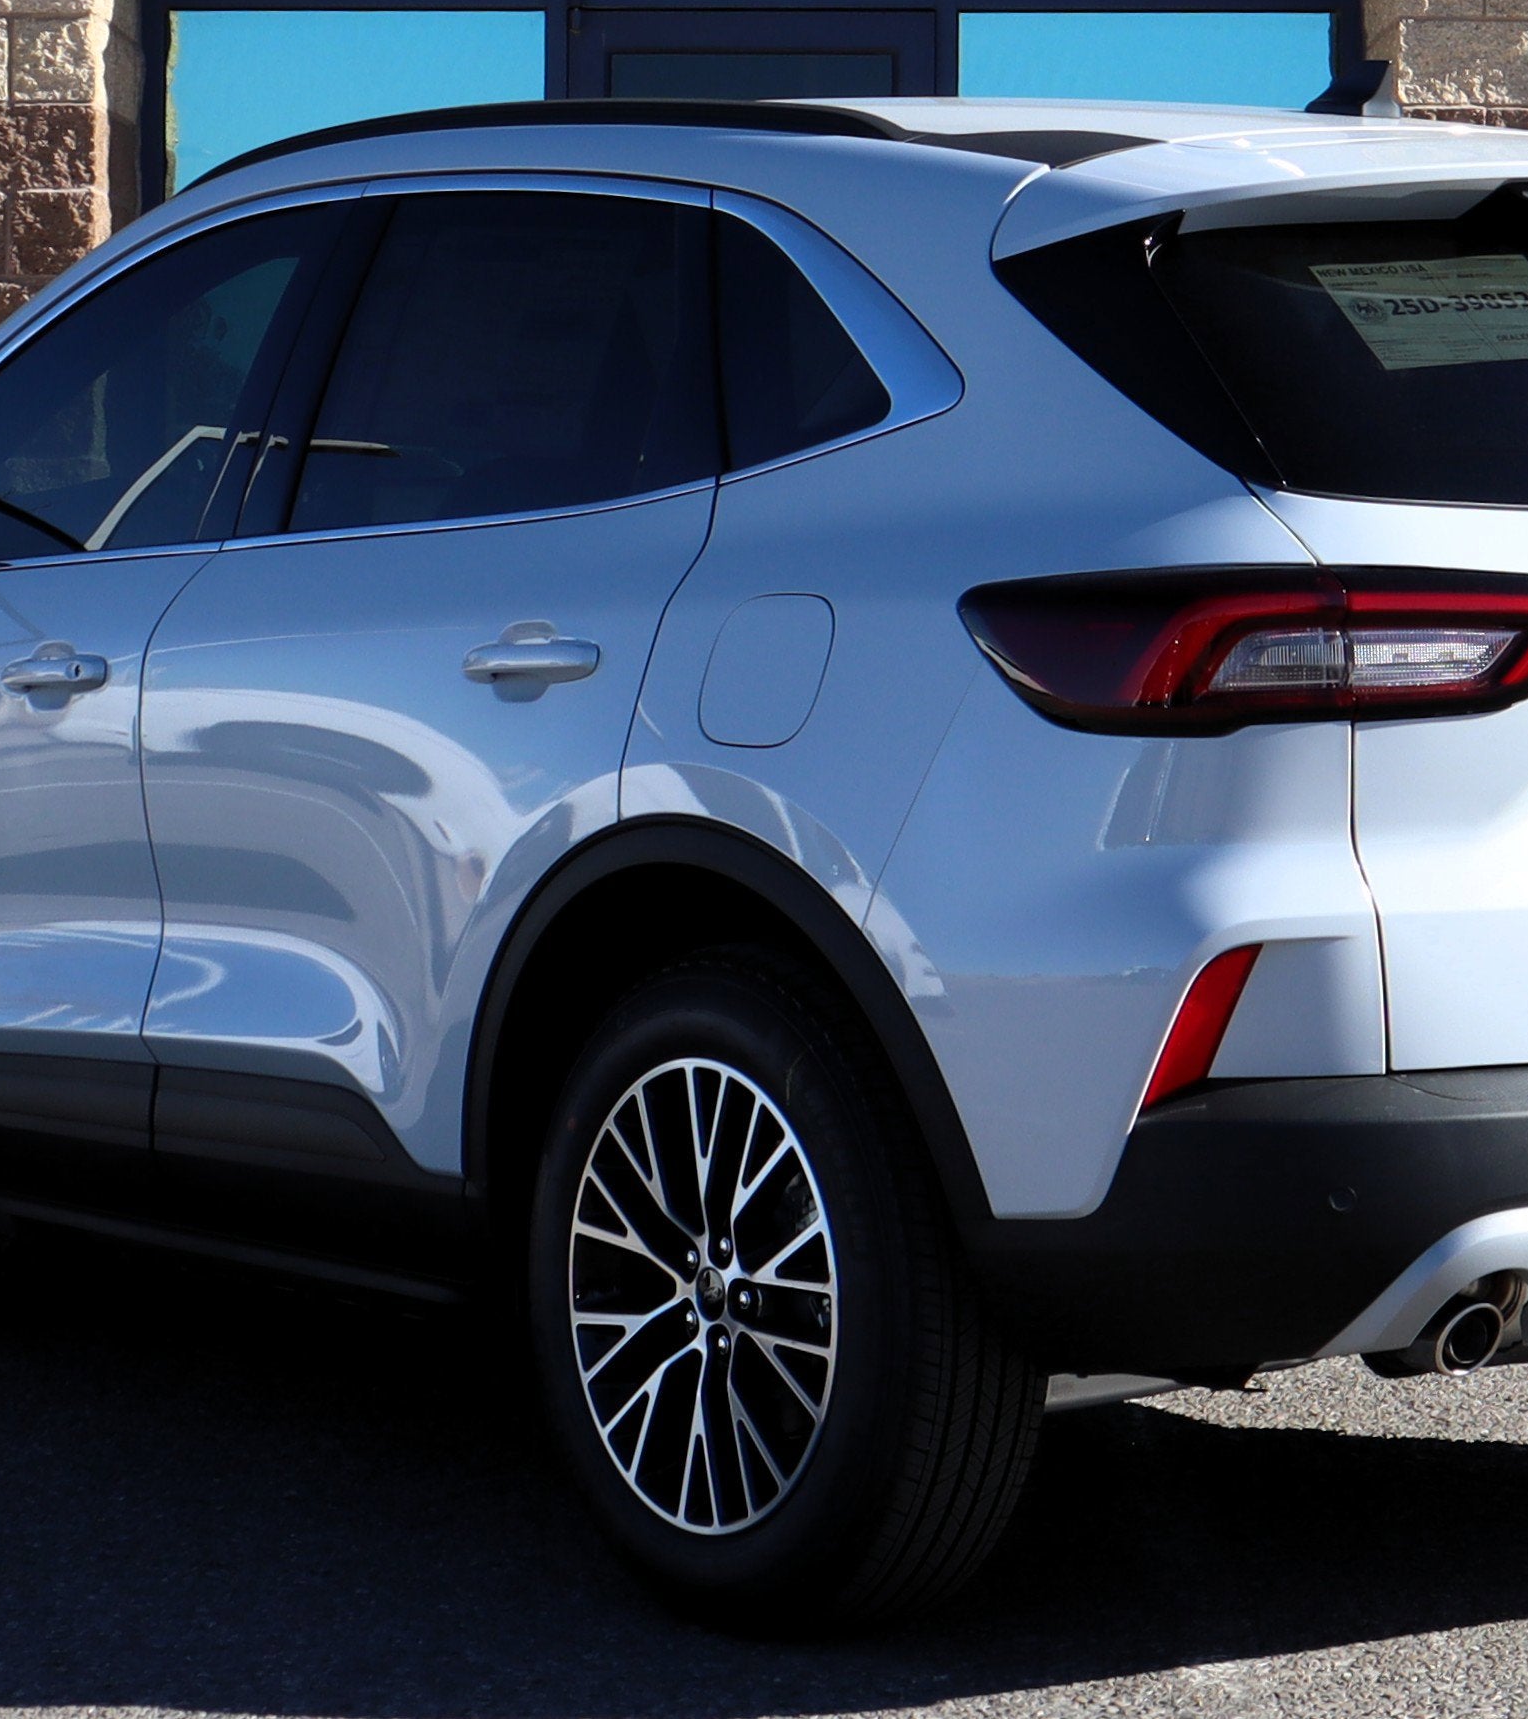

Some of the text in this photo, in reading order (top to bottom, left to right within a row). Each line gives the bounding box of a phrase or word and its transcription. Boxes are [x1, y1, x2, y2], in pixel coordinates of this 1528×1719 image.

[1315, 264, 1428, 278] NEW MEXICO USA
